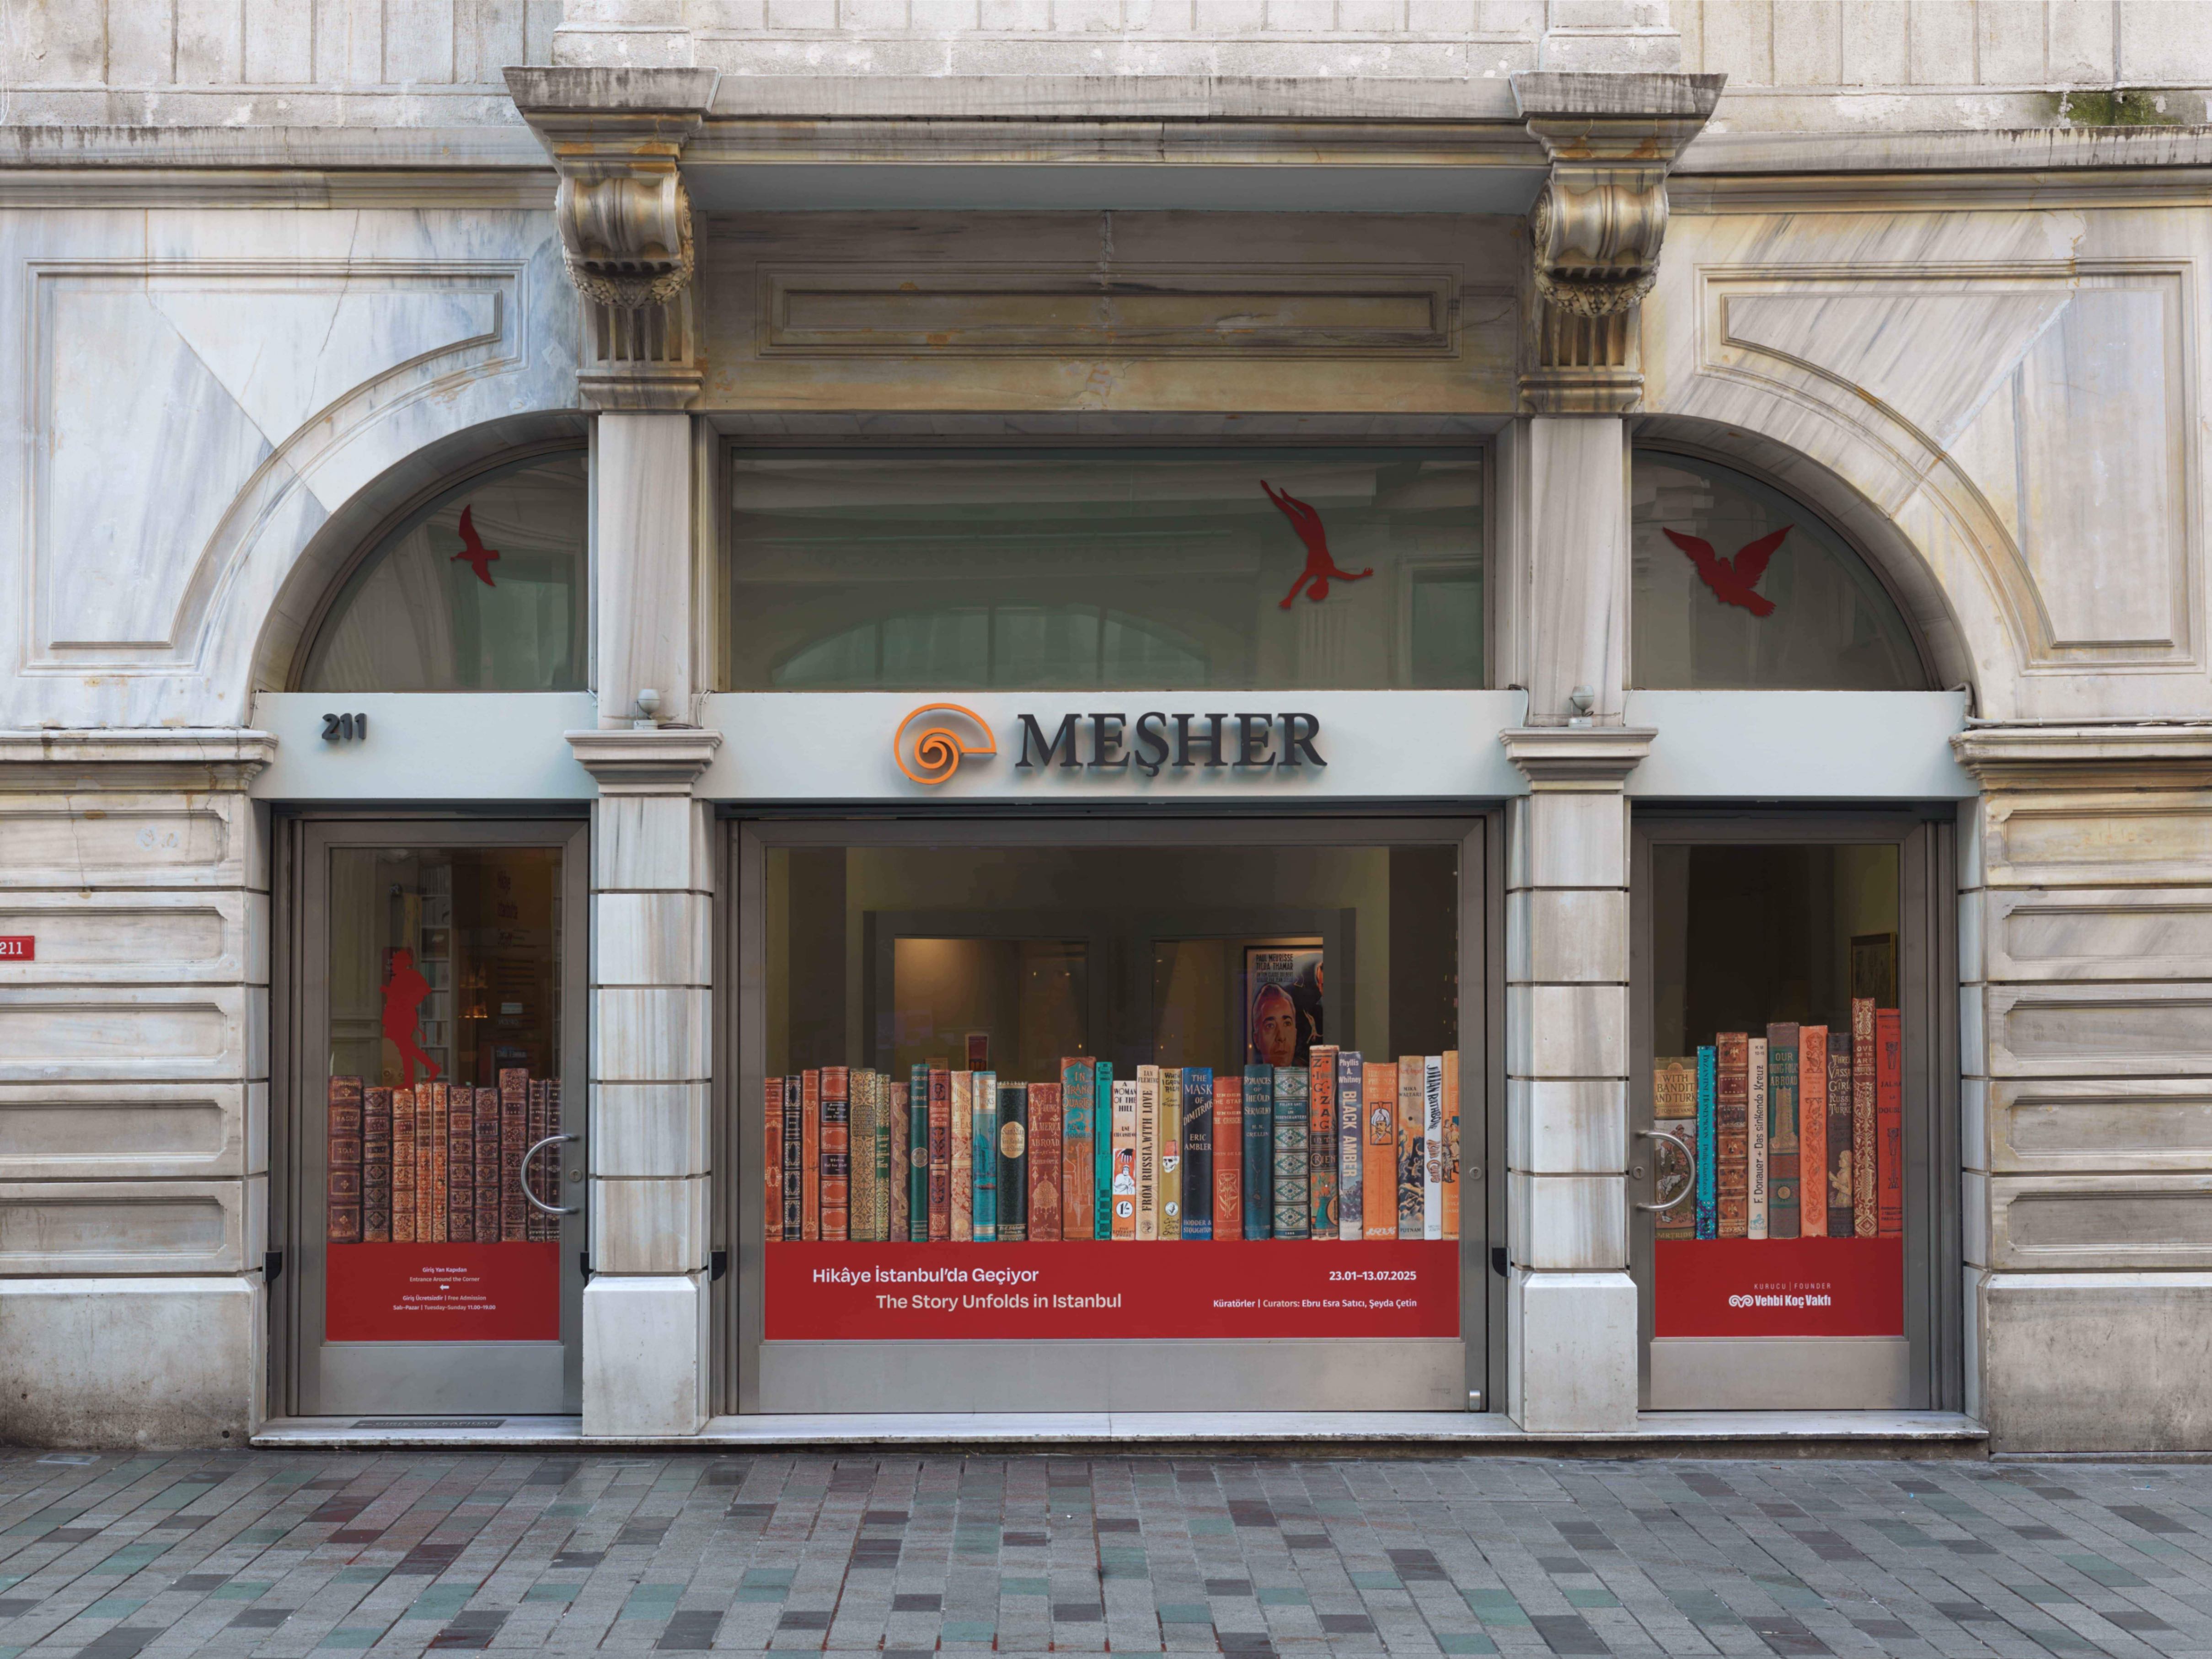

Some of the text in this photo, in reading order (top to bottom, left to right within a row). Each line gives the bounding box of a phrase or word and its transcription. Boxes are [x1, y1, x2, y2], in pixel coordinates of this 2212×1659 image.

[321, 713, 367, 740] 211
[1015, 712, 1328, 777] MEŞHER
[0, 942, 22, 954] 211
[1775, 1053, 1793, 1061] OUR
[1075, 1072, 1085, 1081] IN
[1244, 1076, 1271, 1085] ROMANCES
[1426, 1065, 1441, 1093] JULIAN
[1754, 1065, 1764, 1091] Kreuz
[1770, 1076, 1798, 1086] ABROAD
[1184, 1084, 1213, 1095] MASK
[1657, 1083, 1695, 1092] BANDIT
[1142, 1090, 1153, 1113] LOVE
[1246, 1093, 1270, 1102] THE OLD
[1655, 1093, 1696, 1102] AND TURK
[951, 1100, 971, 1116] TOUR
[1034, 1099, 1057, 1117] YOUNG
[1184, 1098, 1213, 1126] DIMITRIOS
[1244, 1107, 1271, 1116] SERAGLIO
[1754, 1094, 1764, 1132] sinkende
[960, 1118, 972, 1129] EAS
[1031, 1116, 1061, 1133] AMERICA
[1142, 1118, 1153, 1143] WITH
[1342, 1091, 1357, 1177] BLACK AMBER
[1754, 1134, 1764, 1149] Das
[1031, 1139, 1060, 1147] ABROAD
[1311, 1153, 1336, 1166] ORIEN
[1754, 1159, 1764, 1196] Donauer
[1142, 1185, 1152, 1211] FROM
[813, 1267, 871, 1285] Hikâye
[972, 1268, 1039, 1284] Geçiyor
[876, 1293, 1122, 1312] The Story Unfolds in Istanbul
[1213, 1299, 1255, 1308] Küratörler
[1263, 1299, 1300, 1308] Curators:
[1342, 1300, 1367, 1309] Satıcı,
[1369, 1299, 1394, 1309] Şeyda
[1396, 1299, 1417, 1309] Çetin
[1755, 1295, 1831, 1308] Vehbi Koç Vakfı
